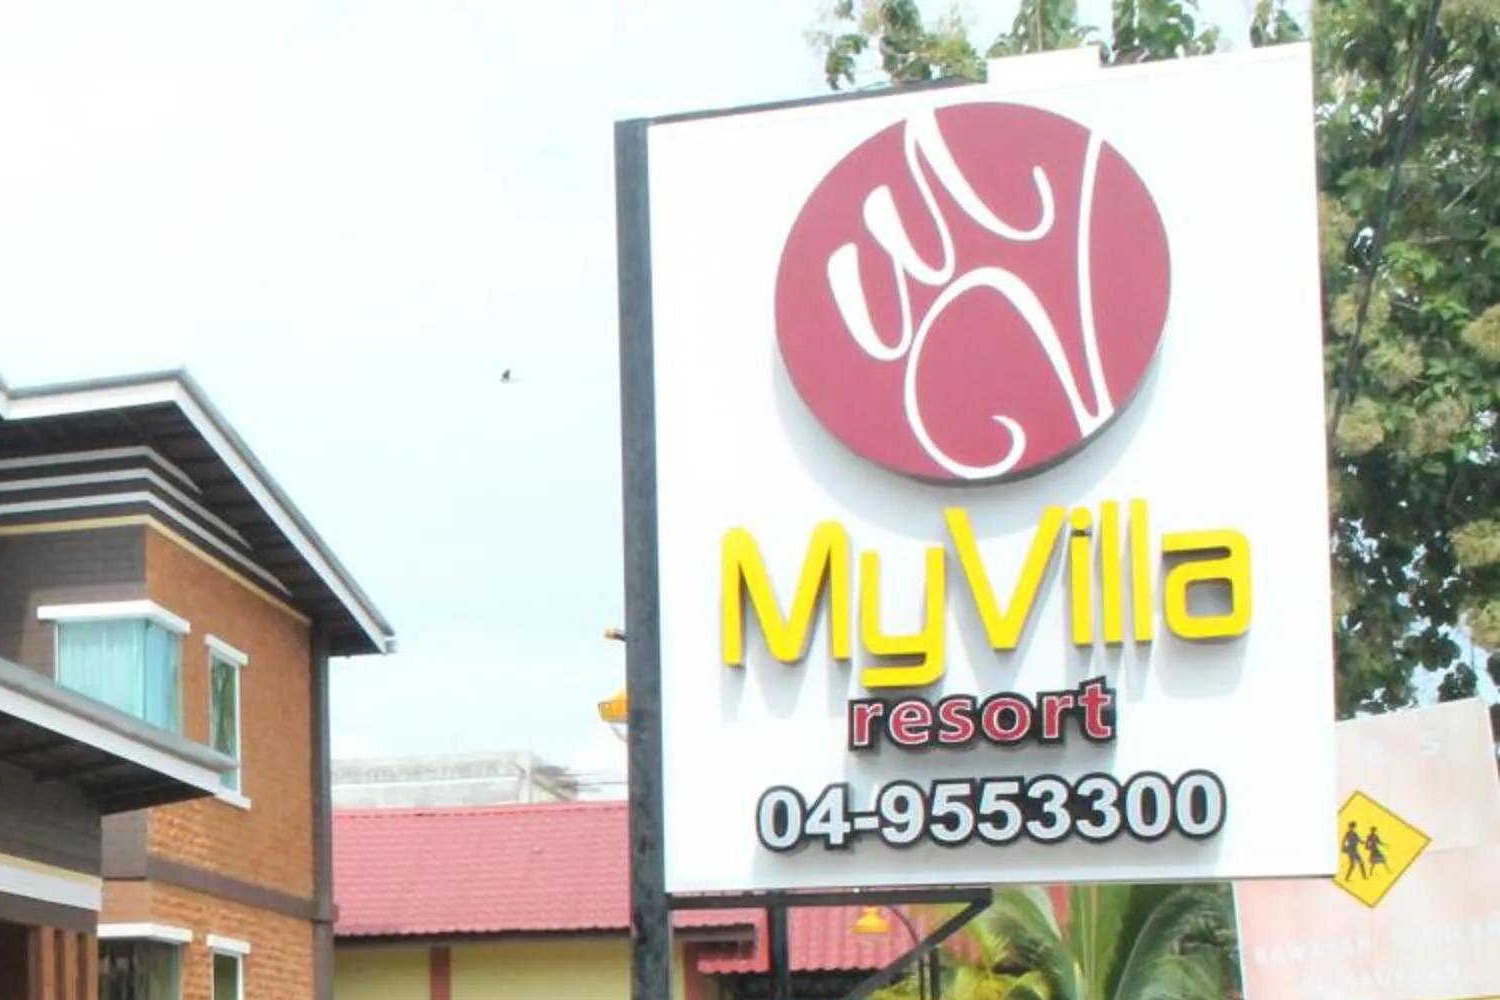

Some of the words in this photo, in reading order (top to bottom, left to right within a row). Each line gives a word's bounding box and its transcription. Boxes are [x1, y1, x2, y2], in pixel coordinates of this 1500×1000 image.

[721, 498, 1253, 688] MyVilla
[849, 676, 1117, 752] resort
[756, 769, 1226, 857] 04-9553300
